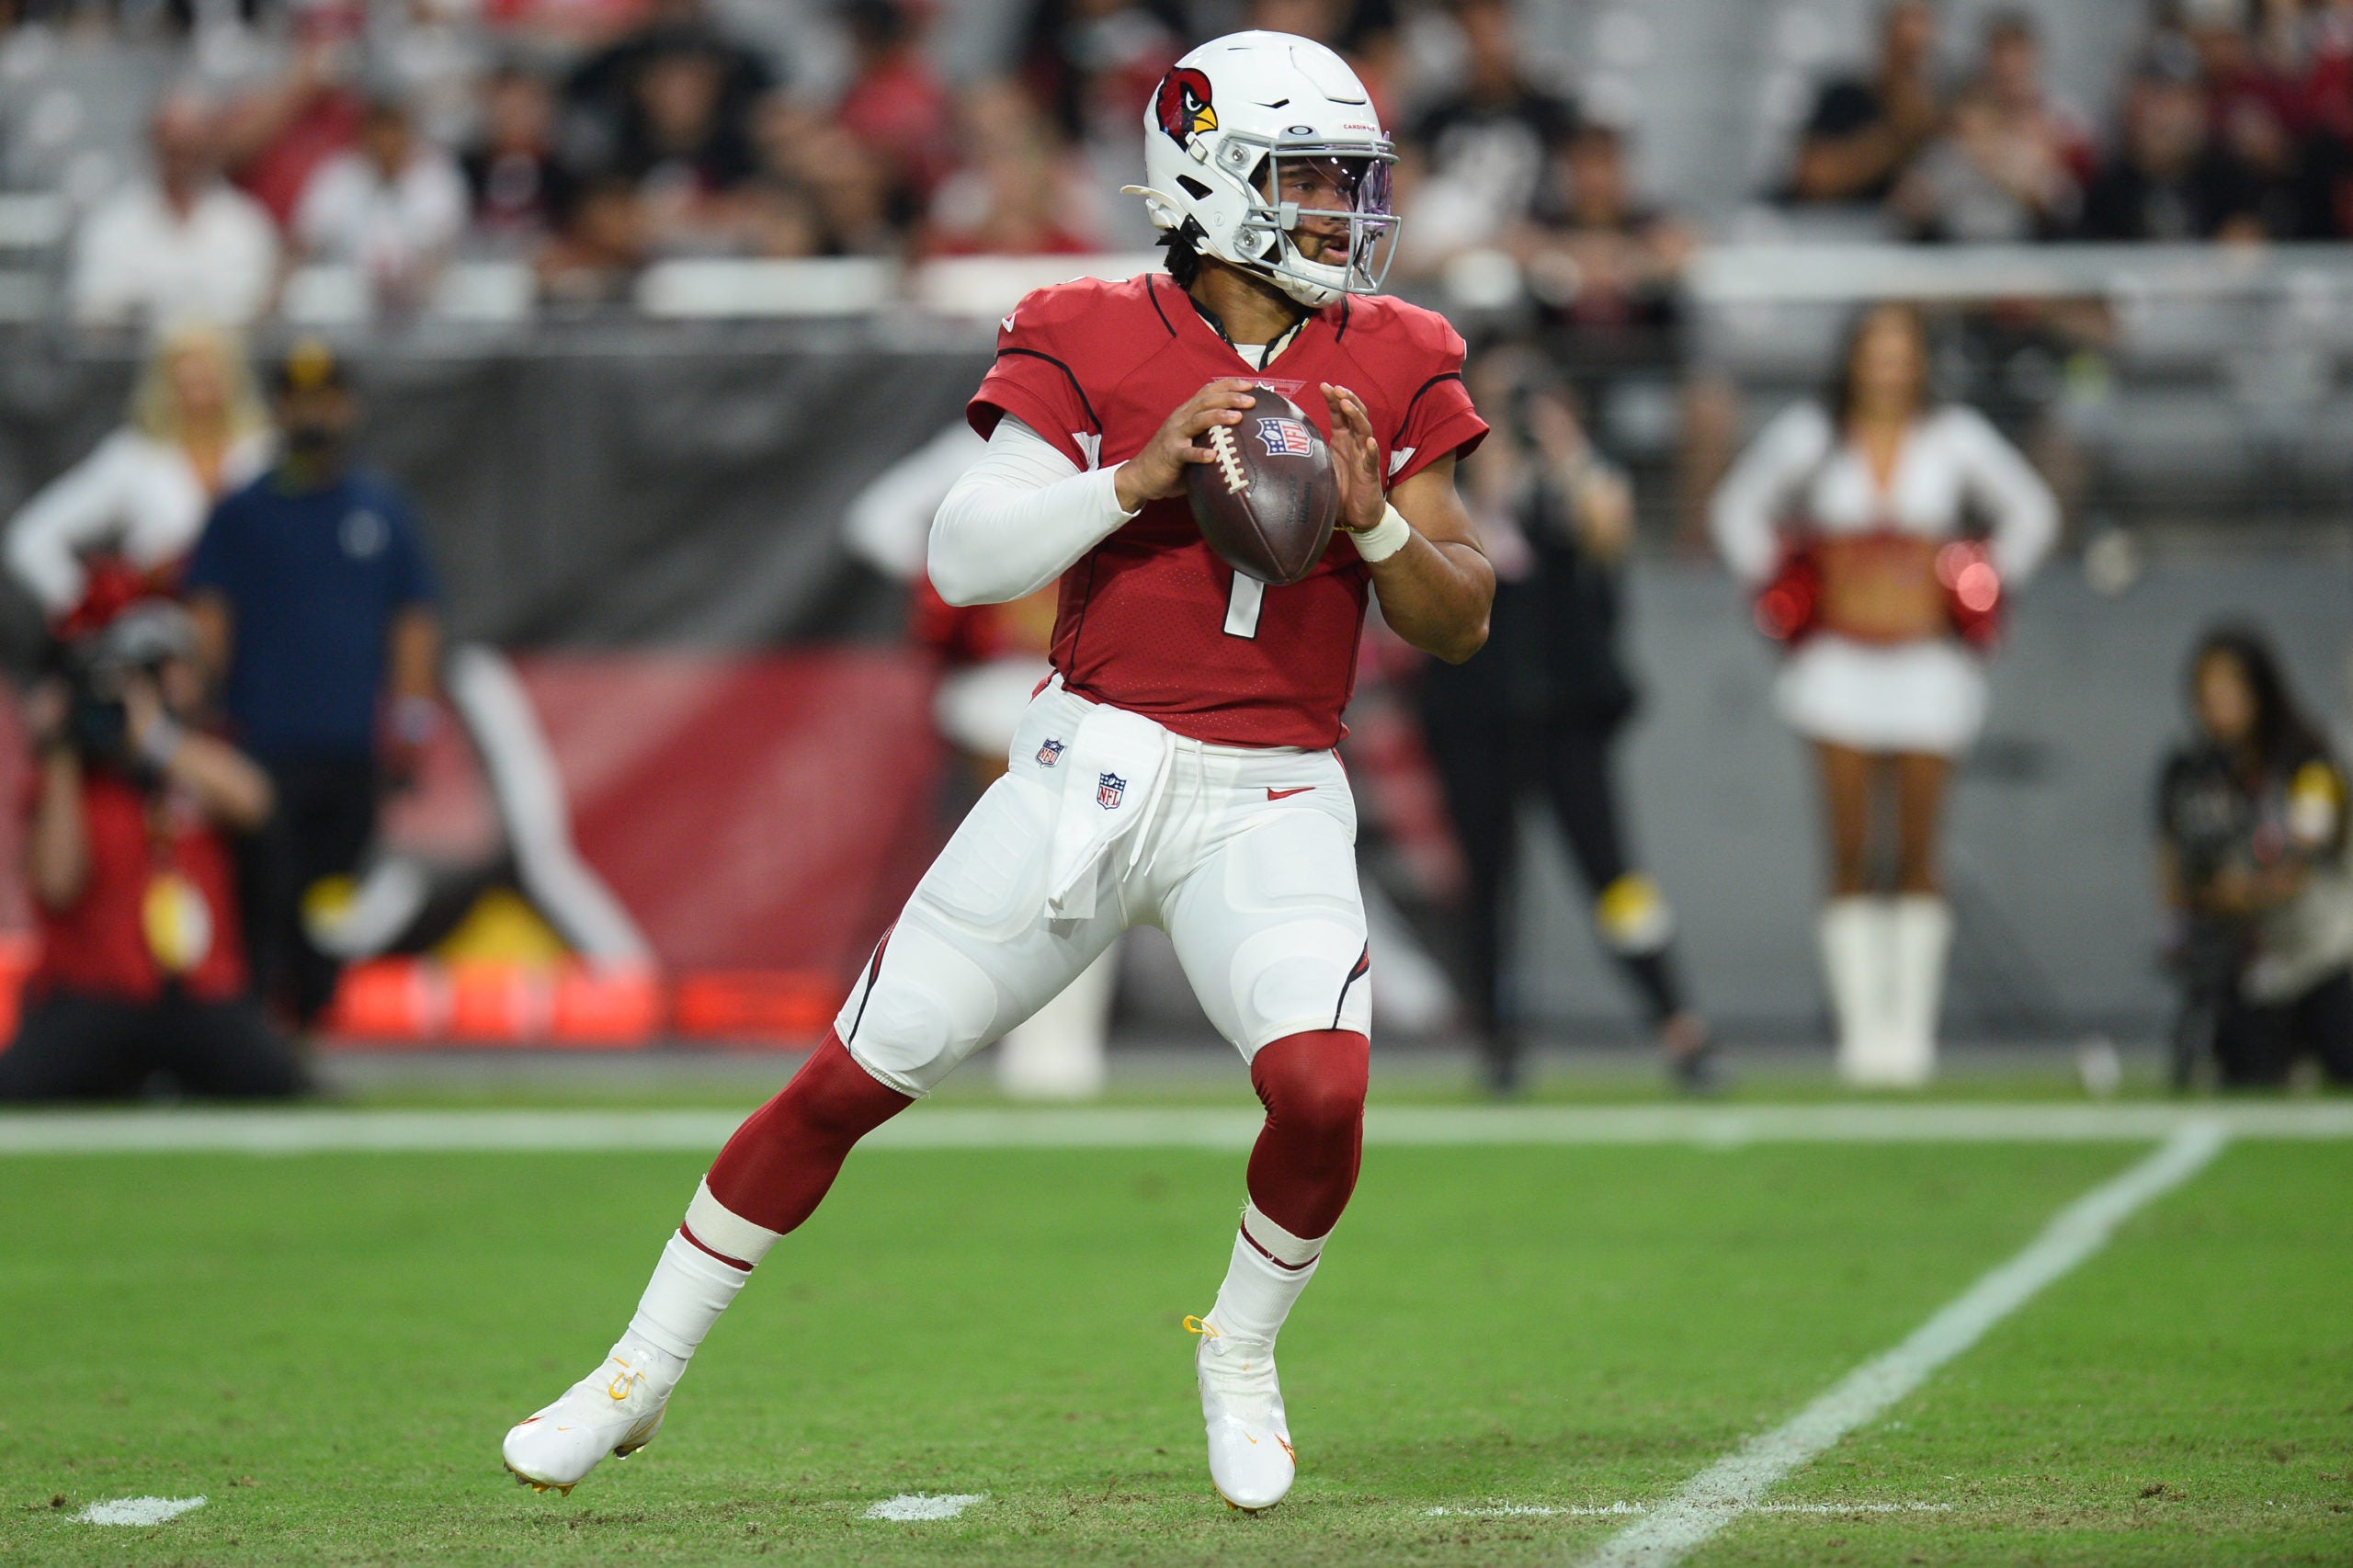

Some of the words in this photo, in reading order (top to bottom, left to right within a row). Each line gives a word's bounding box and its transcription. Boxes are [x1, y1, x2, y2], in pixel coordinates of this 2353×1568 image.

[1282, 424, 1307, 451] NFL
[1039, 747, 1056, 763] NFL
[1097, 785, 1120, 806] NFL
